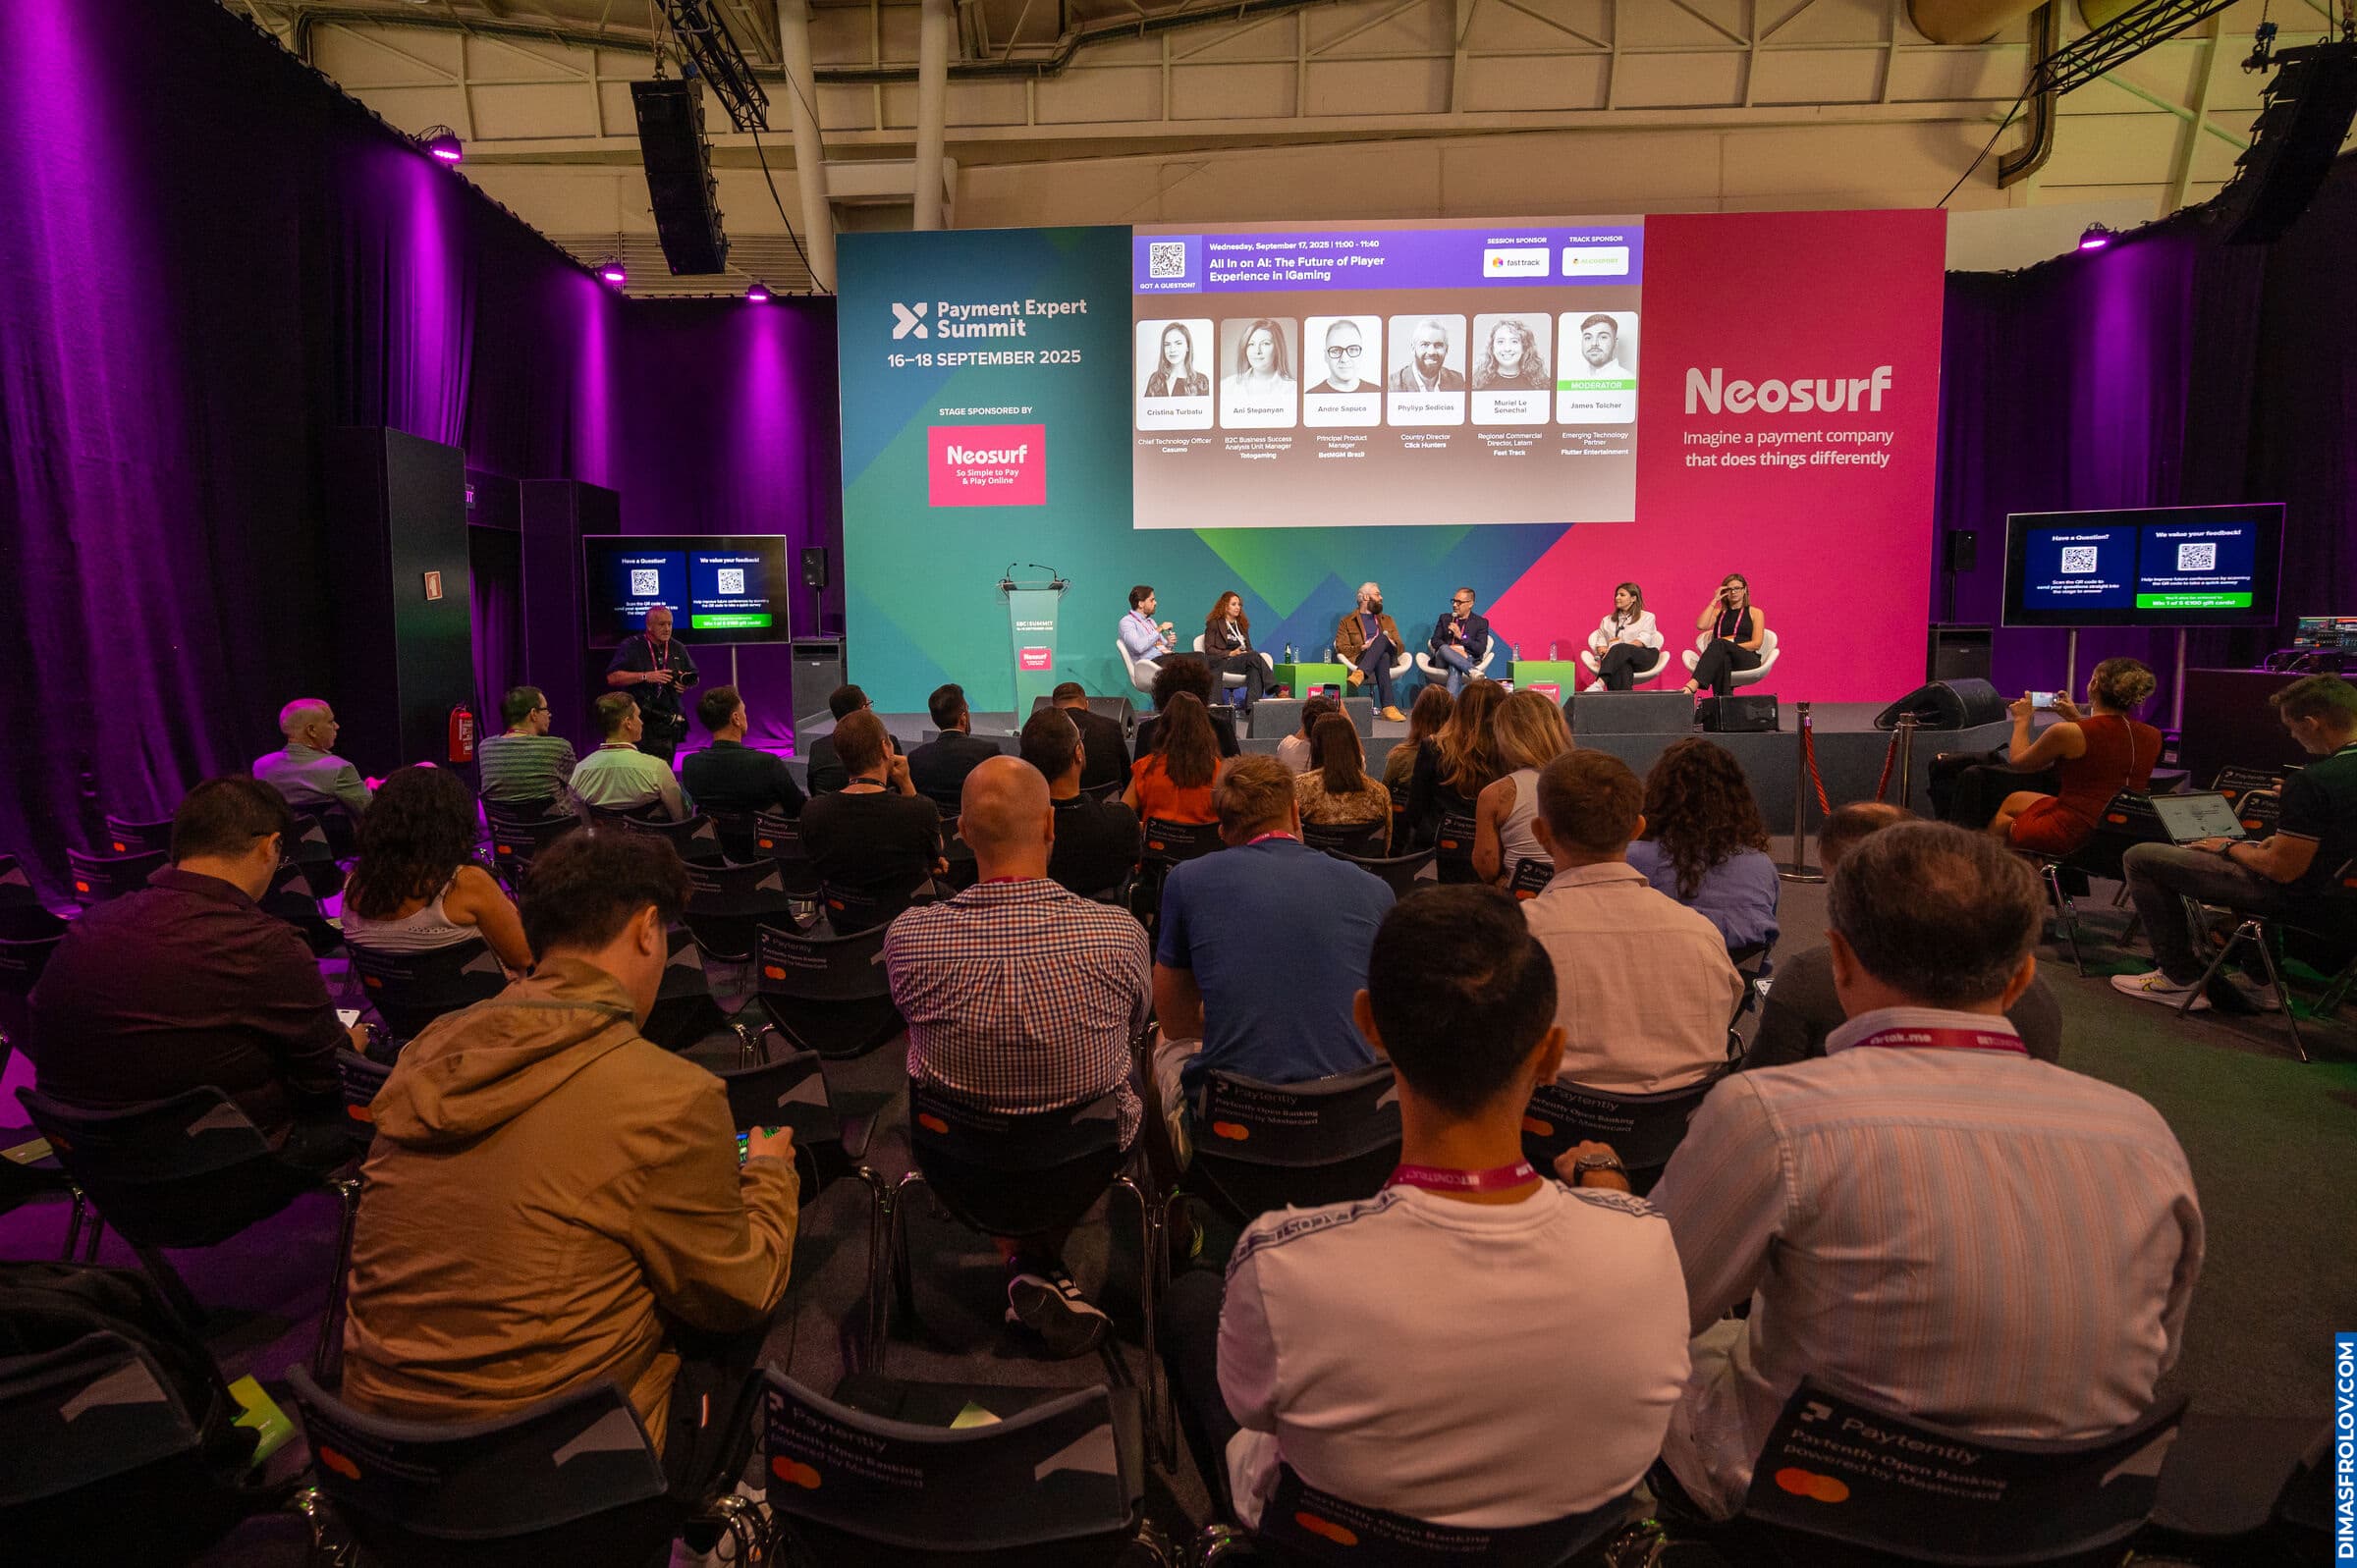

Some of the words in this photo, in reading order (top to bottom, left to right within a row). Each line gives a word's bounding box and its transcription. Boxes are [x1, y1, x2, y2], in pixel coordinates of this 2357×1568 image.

[1209, 243, 1255, 251] Wednesday,
[1255, 242, 1296, 251] September
[1210, 258, 1225, 269] All
[1227, 258, 1238, 268] In
[1257, 257, 1272, 268] AI:
[1275, 257, 1295, 268] The
[1297, 256, 1335, 267] Future
[1337, 256, 1348, 266] of
[1350, 255, 1385, 268] Player
[1210, 271, 1270, 283] Experience
[1272, 271, 1283, 281] in
[937, 300, 1019, 320] Payment
[1025, 298, 1087, 318] Expert
[937, 318, 1026, 339] Summit
[937, 351, 1035, 366] SEPTEMBER
[1039, 350, 1081, 364] 2025
[1684, 365, 1892, 414] Neosurf
[967, 406, 1020, 415] SPONSORED
[1156, 438, 1190, 447] Technology
[1593, 431, 1629, 440] Technology
[1683, 431, 1741, 448] Imagine
[1744, 433, 1754, 443] a
[1758, 430, 1823, 448] payment
[1826, 431, 1894, 447] company
[947, 444, 1028, 464] Neosurf
[1685, 453, 1718, 466] that
[1721, 453, 1756, 465] does
[1760, 451, 1806, 468] things
[1810, 450, 1890, 467] differently
[967, 468, 994, 479] Simple
[1005, 468, 1019, 478] Pay
[969, 477, 986, 486] Play
[988, 476, 1014, 485] Online
[1842, 1417, 1981, 1467] Paytently
